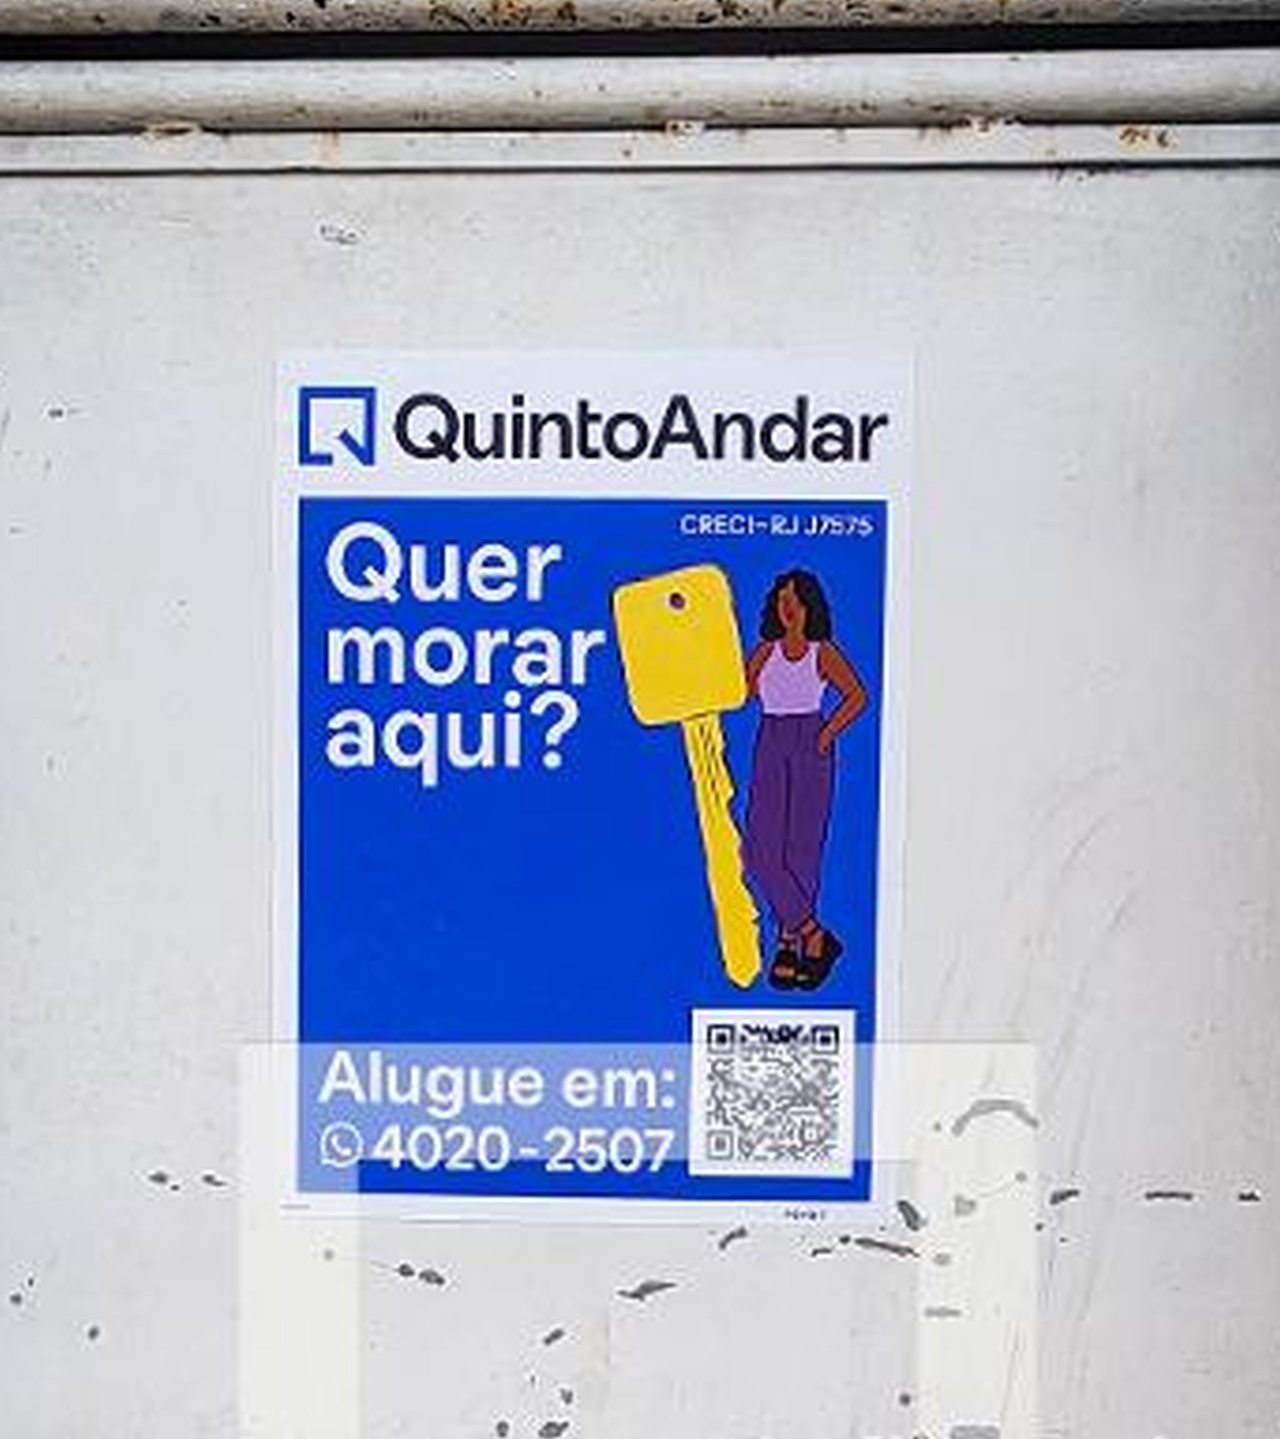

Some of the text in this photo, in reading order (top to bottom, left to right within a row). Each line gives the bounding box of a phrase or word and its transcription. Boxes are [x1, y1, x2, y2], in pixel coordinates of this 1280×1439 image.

[393, 393, 889, 463] QuintoAndar
[325, 521, 562, 603] Quer
[327, 626, 607, 687] morar
[325, 690, 579, 787] aqui?
[319, 1050, 676, 1116] Alugue em:
[372, 1124, 676, 1173] 4020-2507
